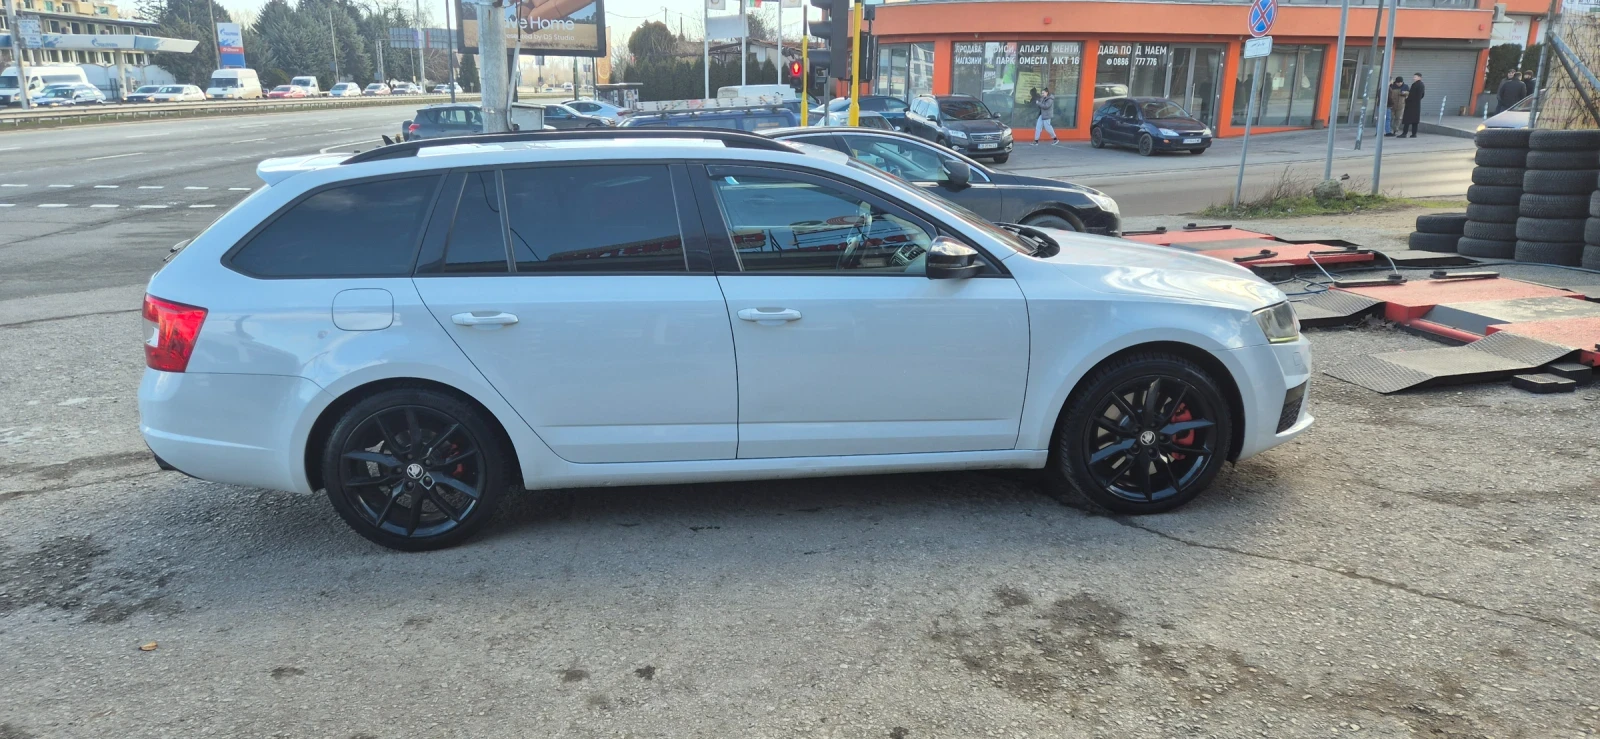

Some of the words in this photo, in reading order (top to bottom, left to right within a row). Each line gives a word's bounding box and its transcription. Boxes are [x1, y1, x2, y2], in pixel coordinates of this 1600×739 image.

[530, 16, 575, 31] Home
[1019, 45, 1049, 53] АПАРТА
[1097, 45, 1119, 55] ДАВА
[1120, 45, 1132, 55] ПО
[1144, 46, 1167, 55] НАЕМ
[995, 56, 1015, 65] ПАРК
[1019, 56, 1048, 65] ОМЕСТА
[1052, 56, 1069, 65] АКТ
